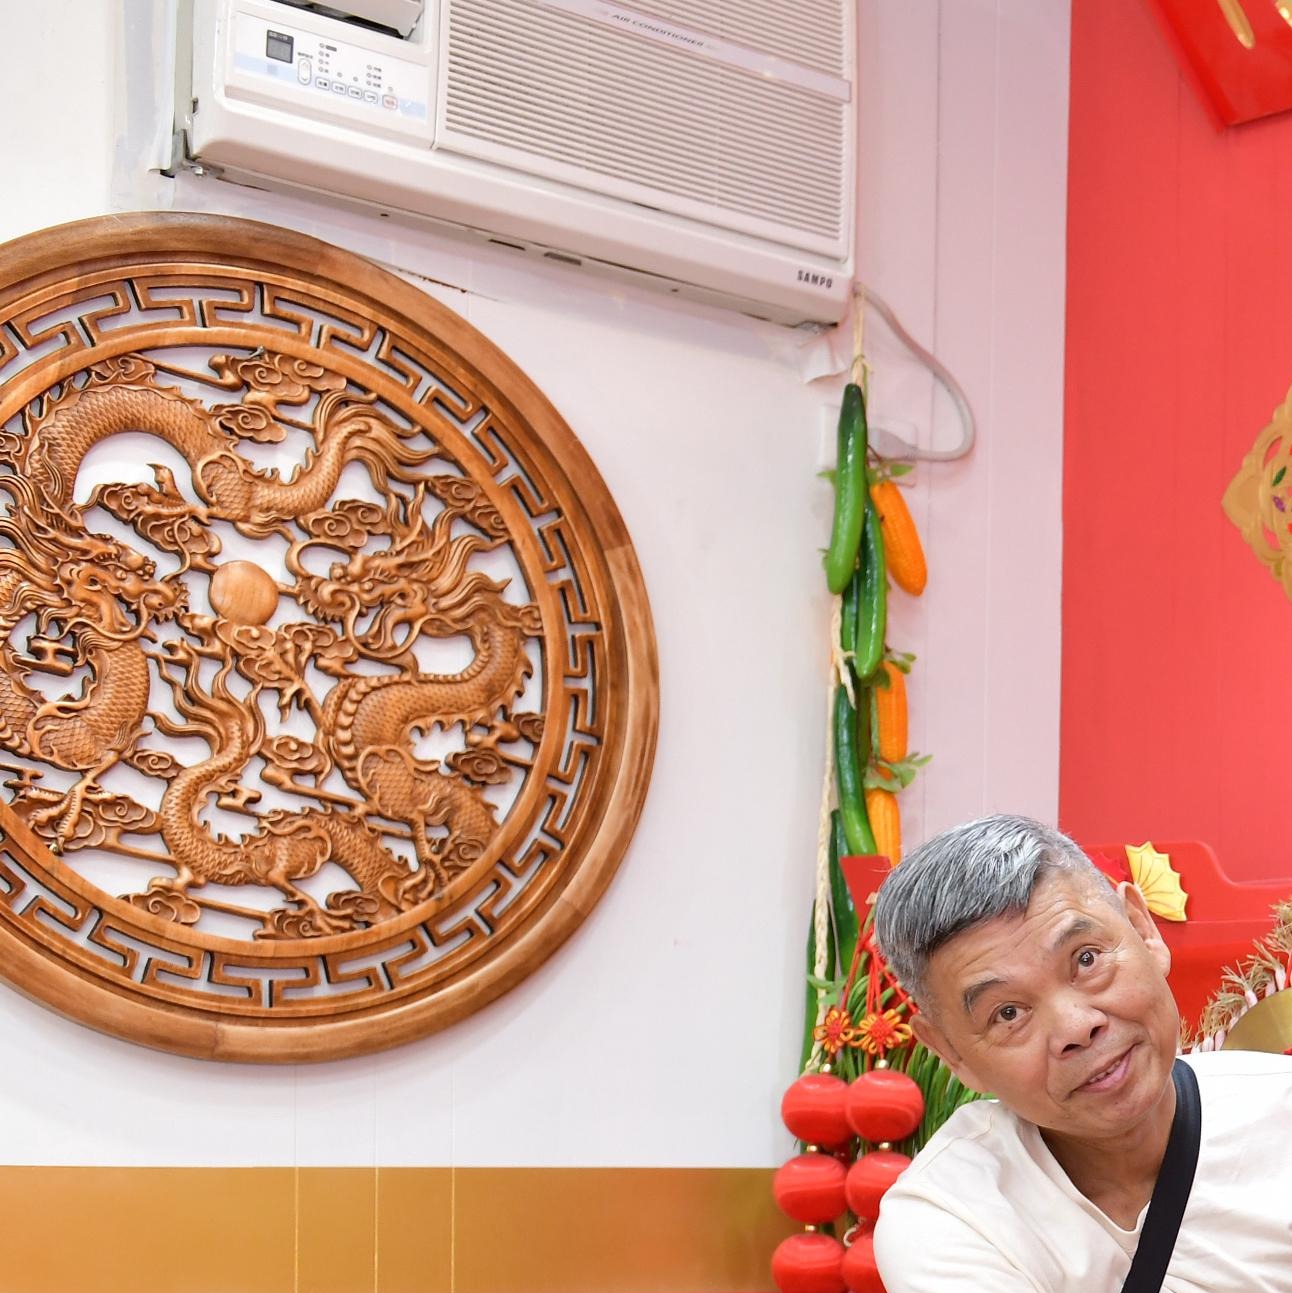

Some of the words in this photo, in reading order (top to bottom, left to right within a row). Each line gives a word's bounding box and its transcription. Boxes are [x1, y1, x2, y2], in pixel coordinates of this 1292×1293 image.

[612, 13, 630, 24] AIR
[632, 20, 704, 47] CONDITIONER
[797, 269, 833, 289] SAMPO
